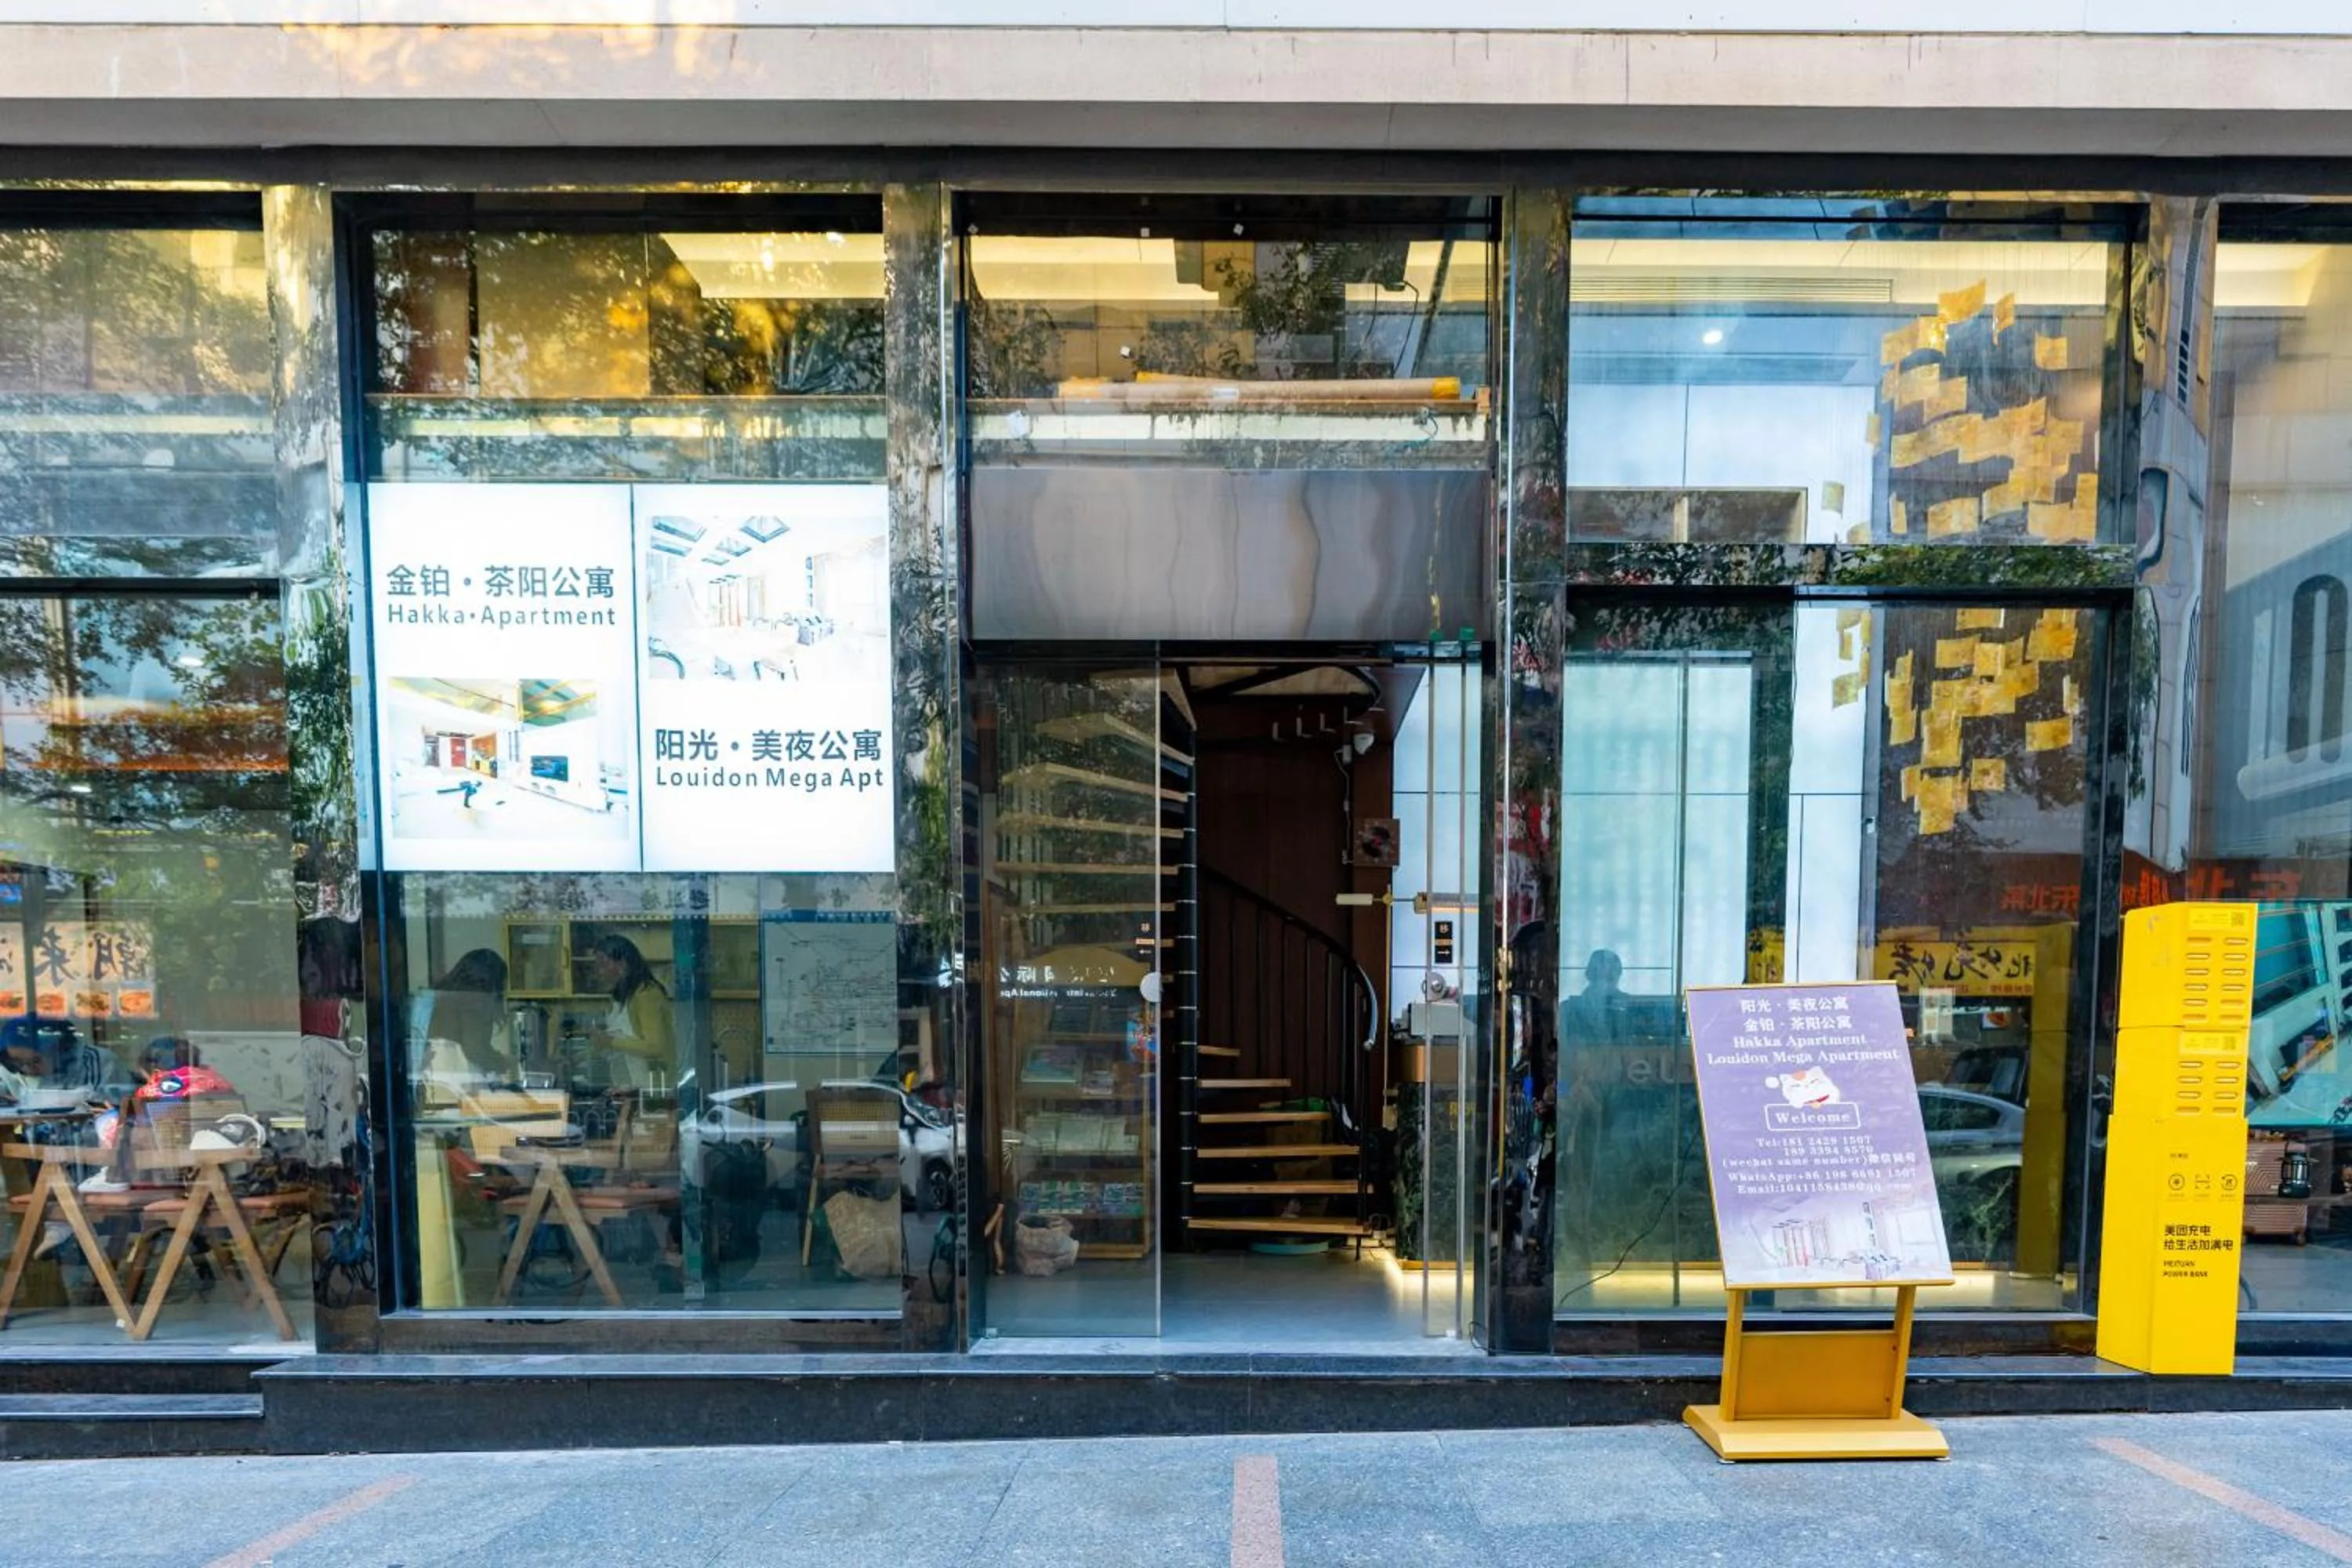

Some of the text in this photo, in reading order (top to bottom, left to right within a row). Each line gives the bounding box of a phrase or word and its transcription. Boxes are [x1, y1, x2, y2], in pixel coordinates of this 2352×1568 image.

[656, 766, 884, 793] Louidon Mega Apt
[1733, 1033, 1868, 1048] Hakka Apartment
[1706, 1049, 1901, 1065] Louidon Mega Apartment
[1774, 1111, 1850, 1124] Welcome
